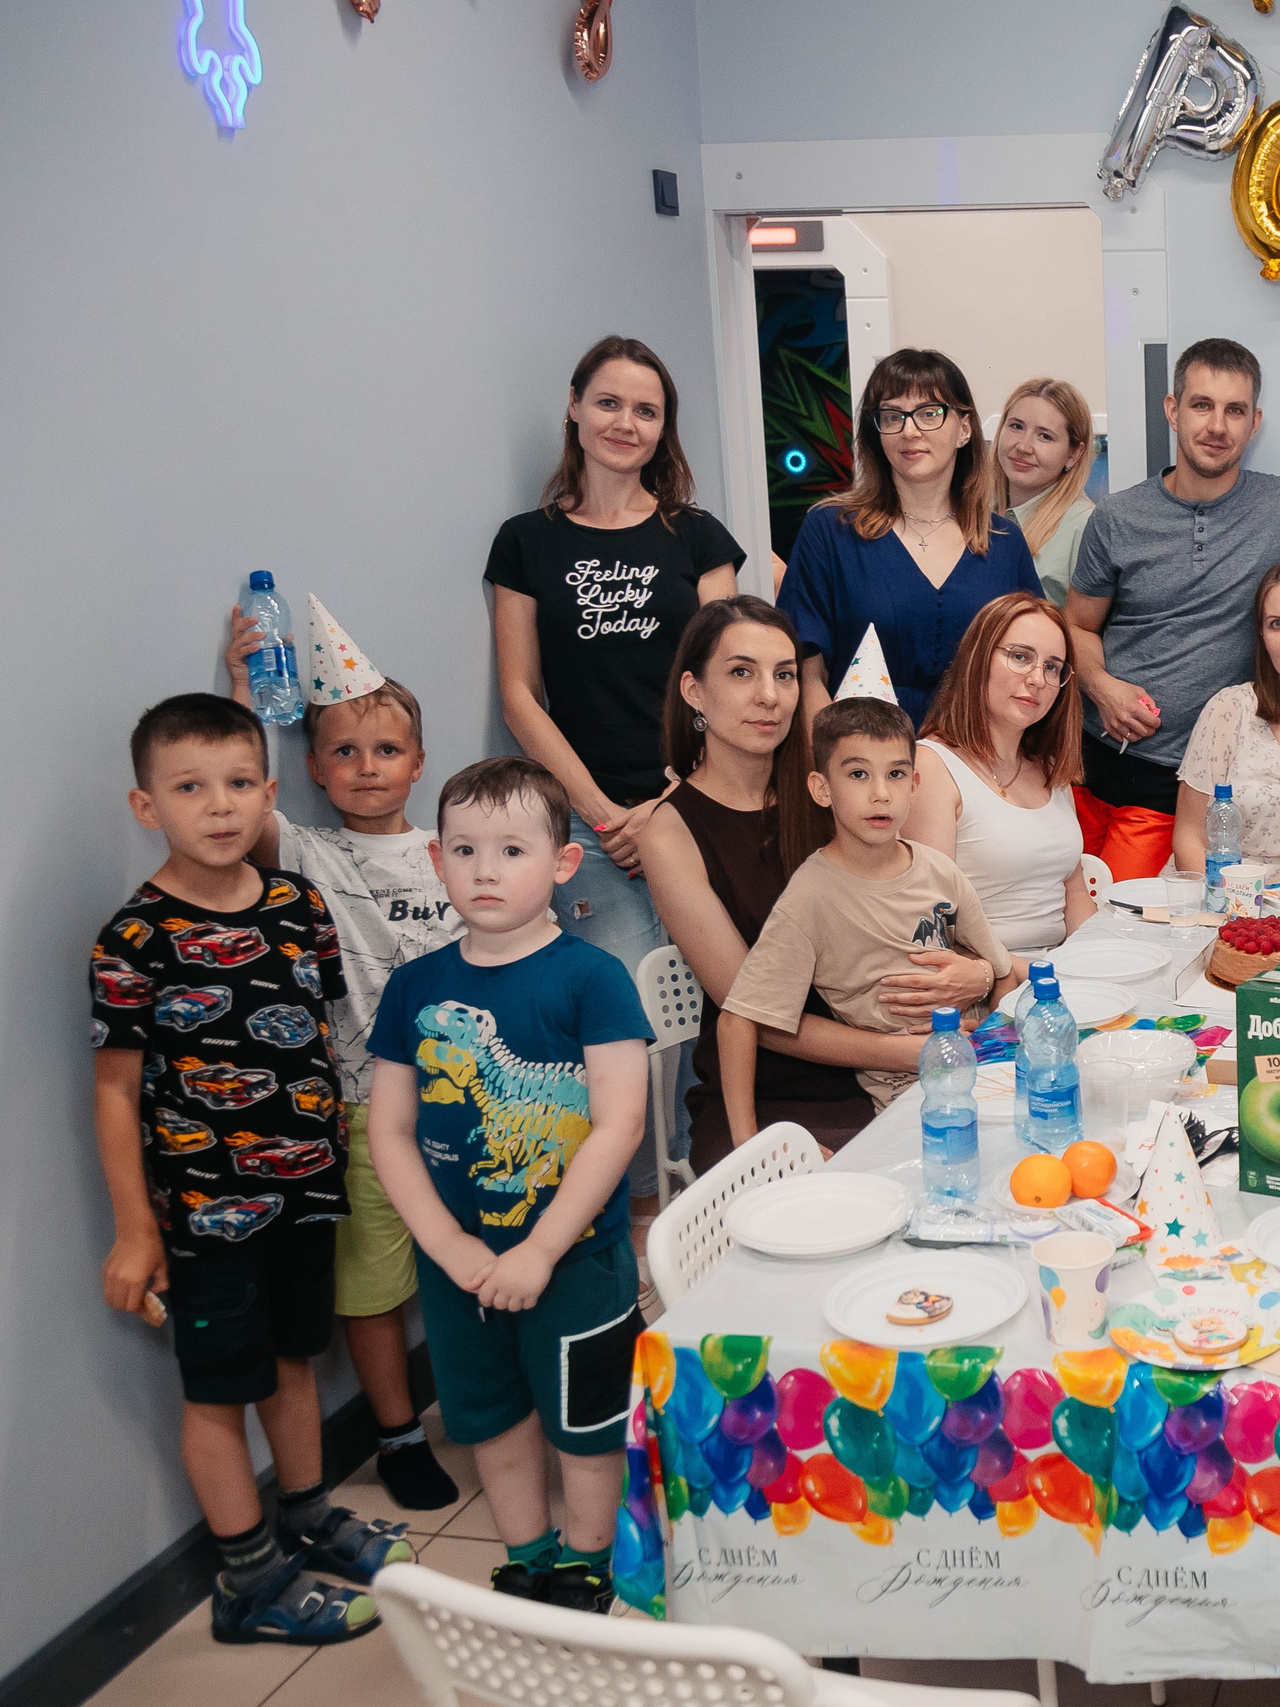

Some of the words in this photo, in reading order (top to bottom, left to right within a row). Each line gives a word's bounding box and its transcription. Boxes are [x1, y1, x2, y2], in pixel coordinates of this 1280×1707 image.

[565, 559, 659, 585] Feeling
[577, 582, 653, 608] Lucky
[577, 603, 660, 639] Today
[250, 979, 281, 991] DRIVE
[201, 1037, 241, 1047] DRIVE
[698, 1549, 712, 1566] С
[717, 1546, 778, 1567] ДНЁМ
[917, 1549, 931, 1568] С
[936, 1547, 1001, 1571] ДНЁМ
[1117, 1566, 1132, 1586] С
[1137, 1567, 1209, 1590] ДНЁМ
